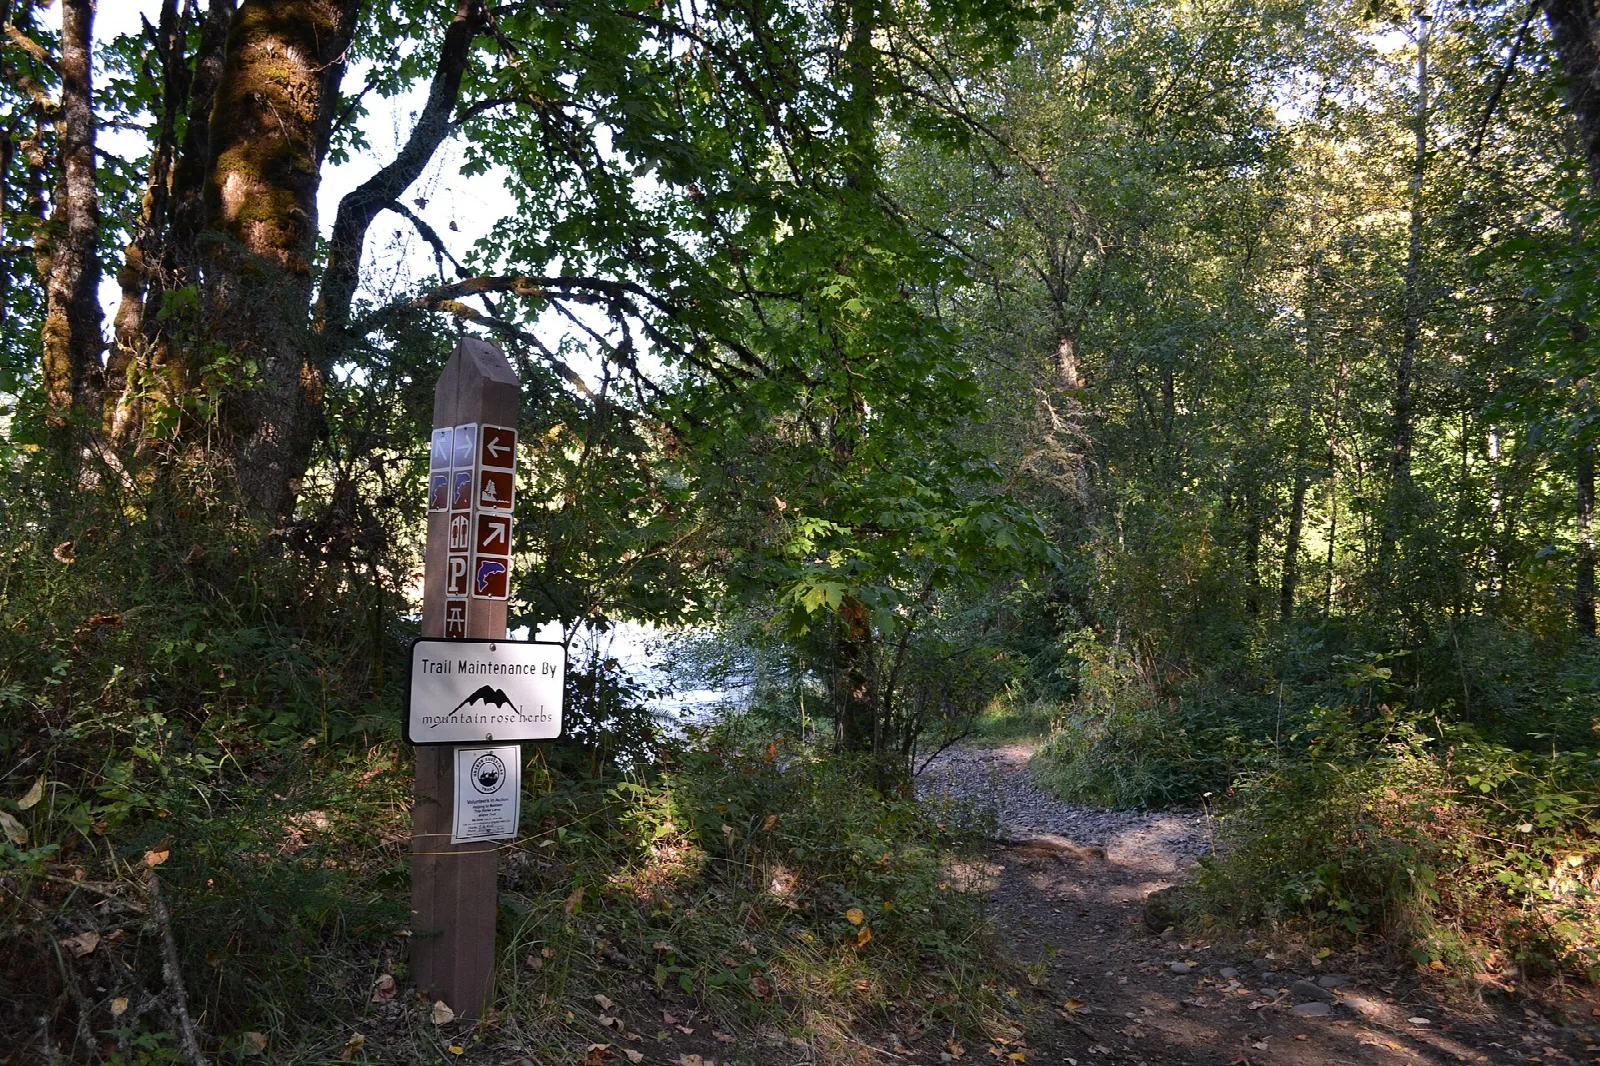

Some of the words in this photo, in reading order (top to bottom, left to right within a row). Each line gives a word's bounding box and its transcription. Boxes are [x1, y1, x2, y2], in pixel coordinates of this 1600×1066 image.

[448, 557, 467, 592] P
[421, 658, 452, 674] Trail
[457, 659, 536, 675] Maintenance
[541, 661, 557, 679] By
[422, 712, 487, 725] mountain
[490, 713, 516, 724] rose
[519, 705, 553, 723] herbs
